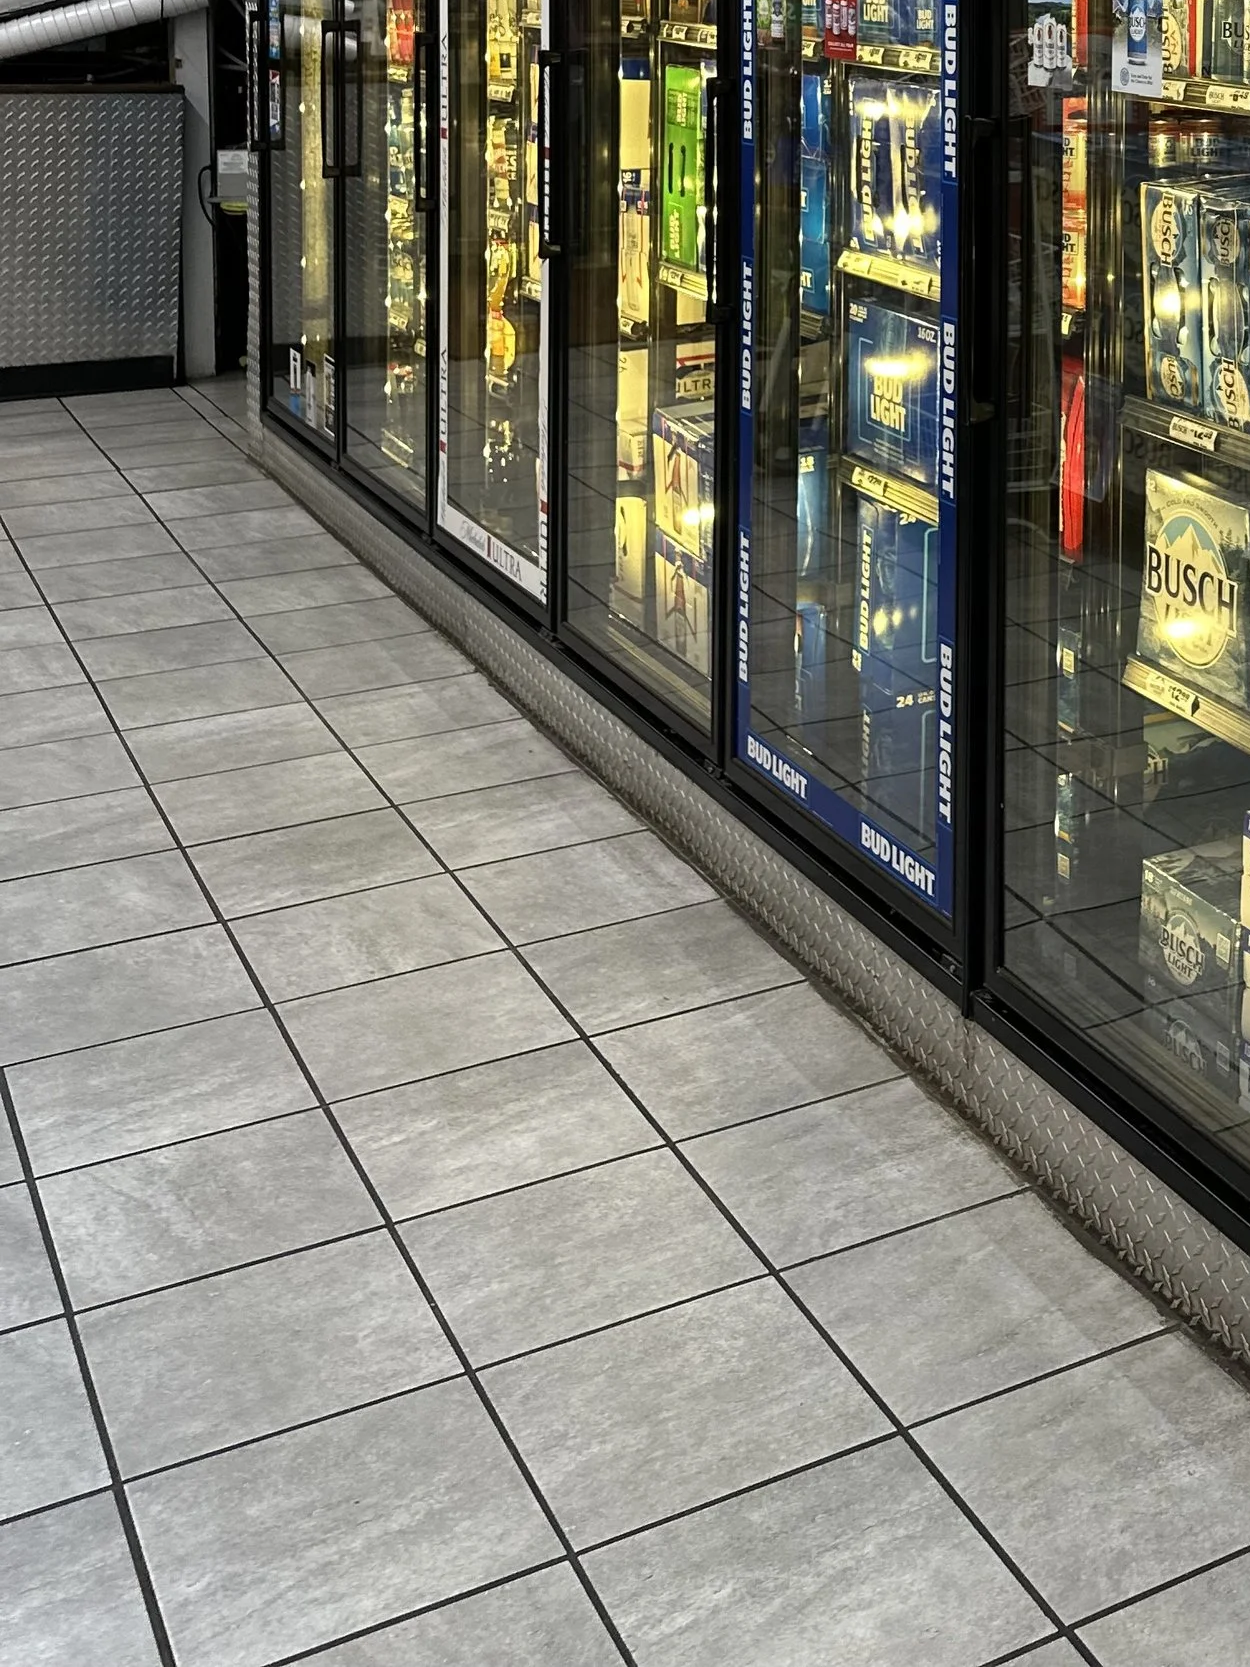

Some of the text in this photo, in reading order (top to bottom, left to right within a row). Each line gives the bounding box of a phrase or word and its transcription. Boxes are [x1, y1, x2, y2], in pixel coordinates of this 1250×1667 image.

[863, 3, 889, 23] LIGHT
[916, 18, 933, 30] LIGHT
[918, 9, 932, 19] BUD
[743, 87, 753, 139] BUD
[944, 5, 957, 178] BUD LIGHT
[1162, 193, 1174, 267] BUSCH
[742, 263, 753, 410] BUD LIGHT
[870, 399, 906, 434] LIGHT
[941, 323, 955, 499] BUD LIGHT
[1221, 357, 1240, 429] BUSCH
[492, 548, 522, 582] ULTRA
[860, 530, 872, 650] BUD LIGHT
[1146, 544, 1237, 635] BUSCH
[739, 533, 750, 681] BUD LIGHT
[896, 694, 914, 708] 24
[939, 644, 952, 822] BUD LIGHT
[747, 736, 807, 800] BUD LIGHT
[861, 822, 935, 897] BUD LIGHT
[1160, 923, 1206, 971] BUSCH
[1167, 952, 1196, 980] LIGHT
